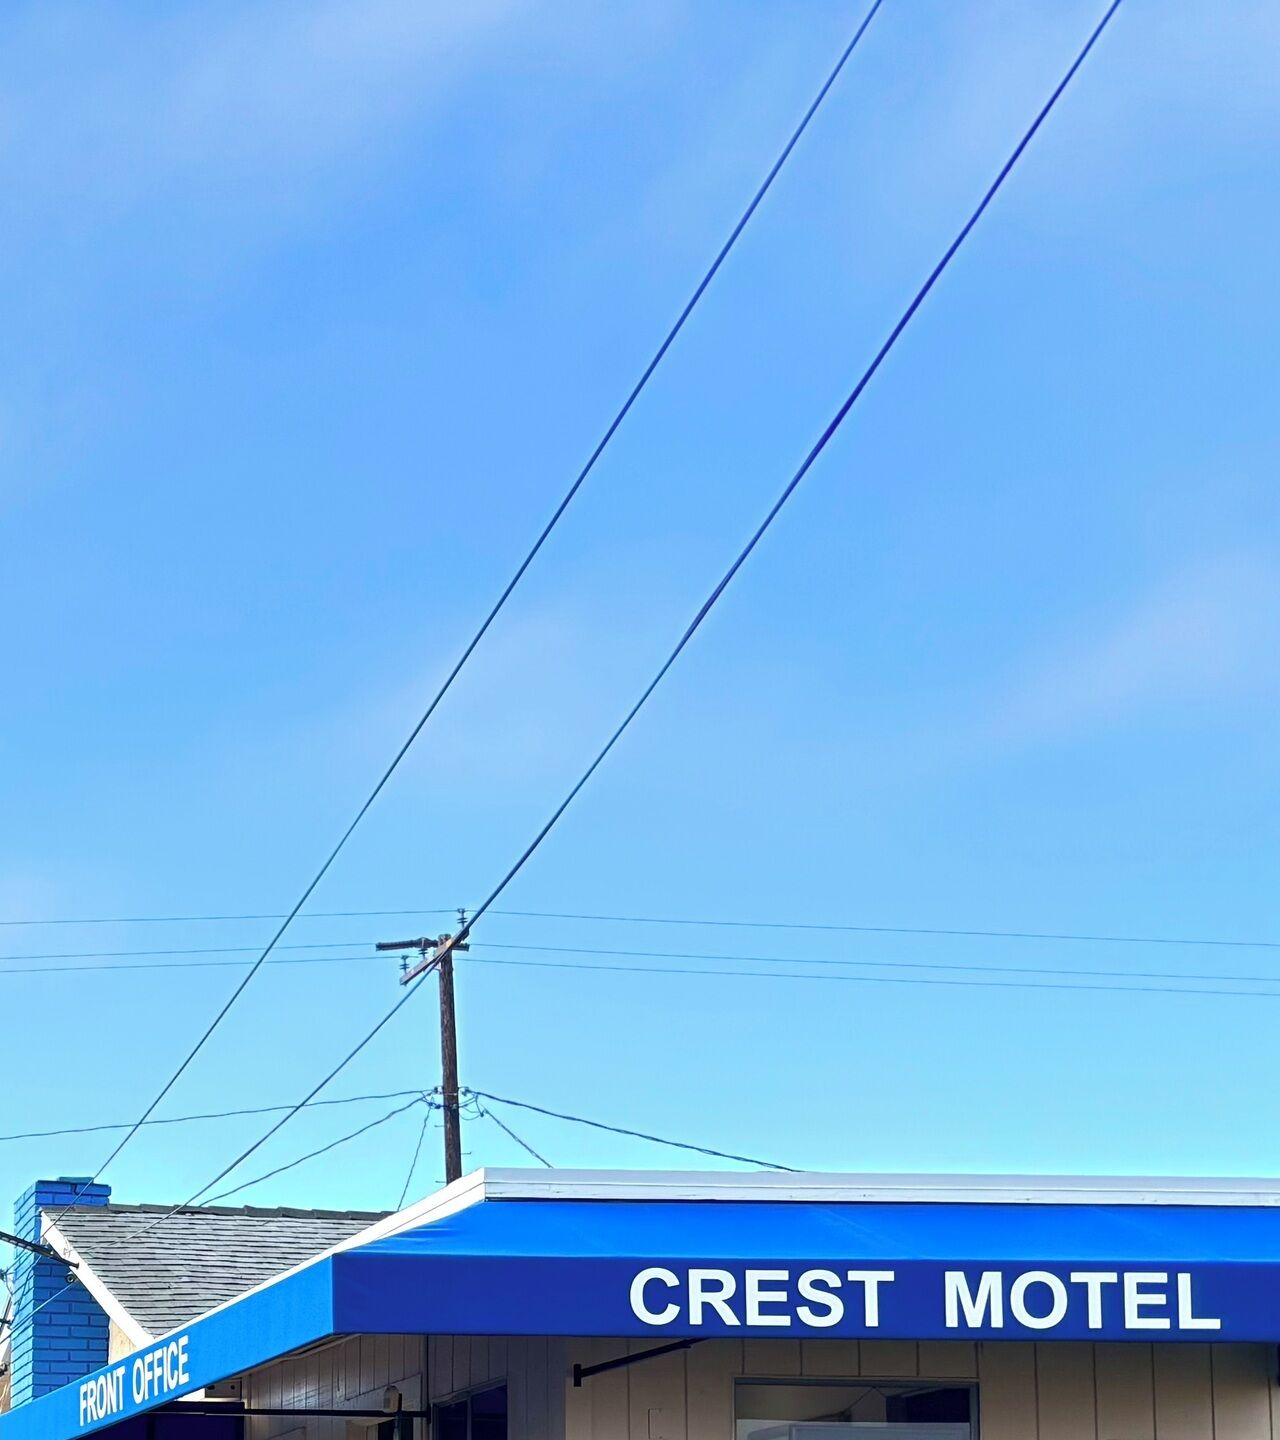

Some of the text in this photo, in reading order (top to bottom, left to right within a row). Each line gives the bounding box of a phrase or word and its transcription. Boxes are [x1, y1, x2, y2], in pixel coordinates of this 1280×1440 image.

[628, 1267, 1221, 1330] CREST MOTEL
[80, 1335, 189, 1427] FRONT OFFICE
